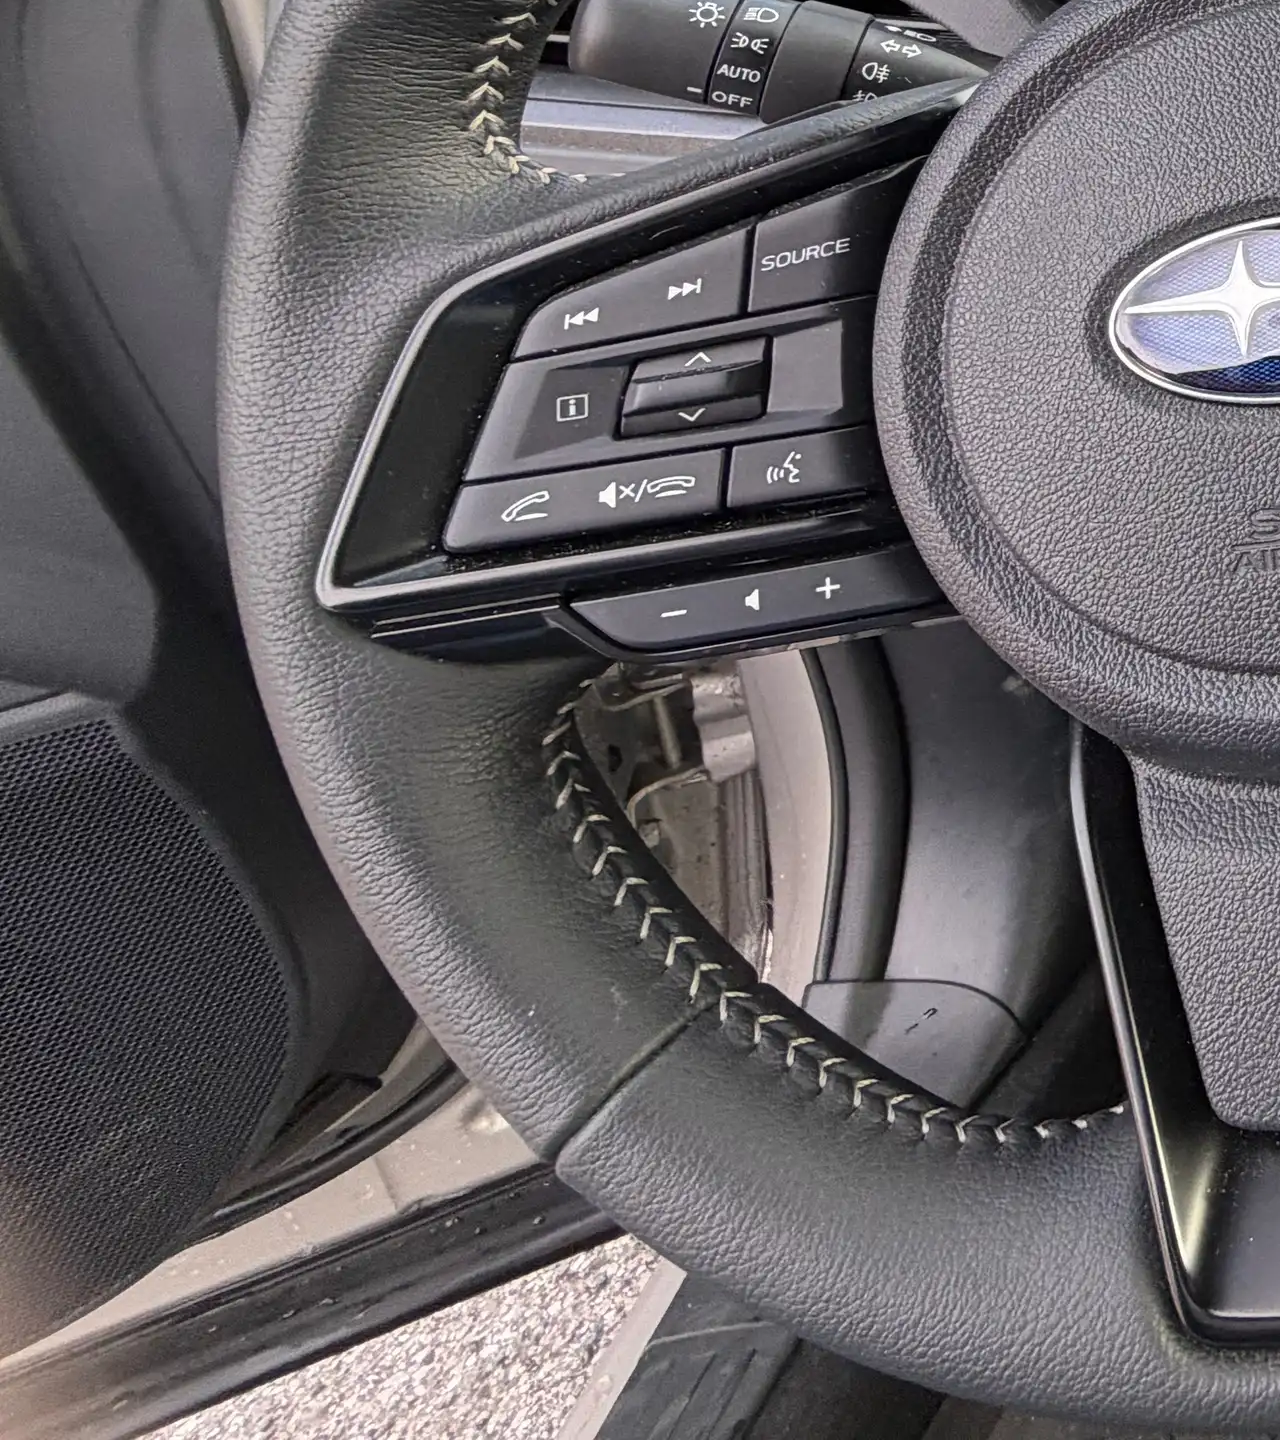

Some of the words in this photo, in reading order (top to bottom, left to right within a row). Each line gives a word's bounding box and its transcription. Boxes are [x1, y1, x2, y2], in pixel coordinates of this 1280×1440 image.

[717, 64, 761, 84] AUTO
[712, 90, 754, 108] OFF
[761, 238, 851, 272] SOURCE
